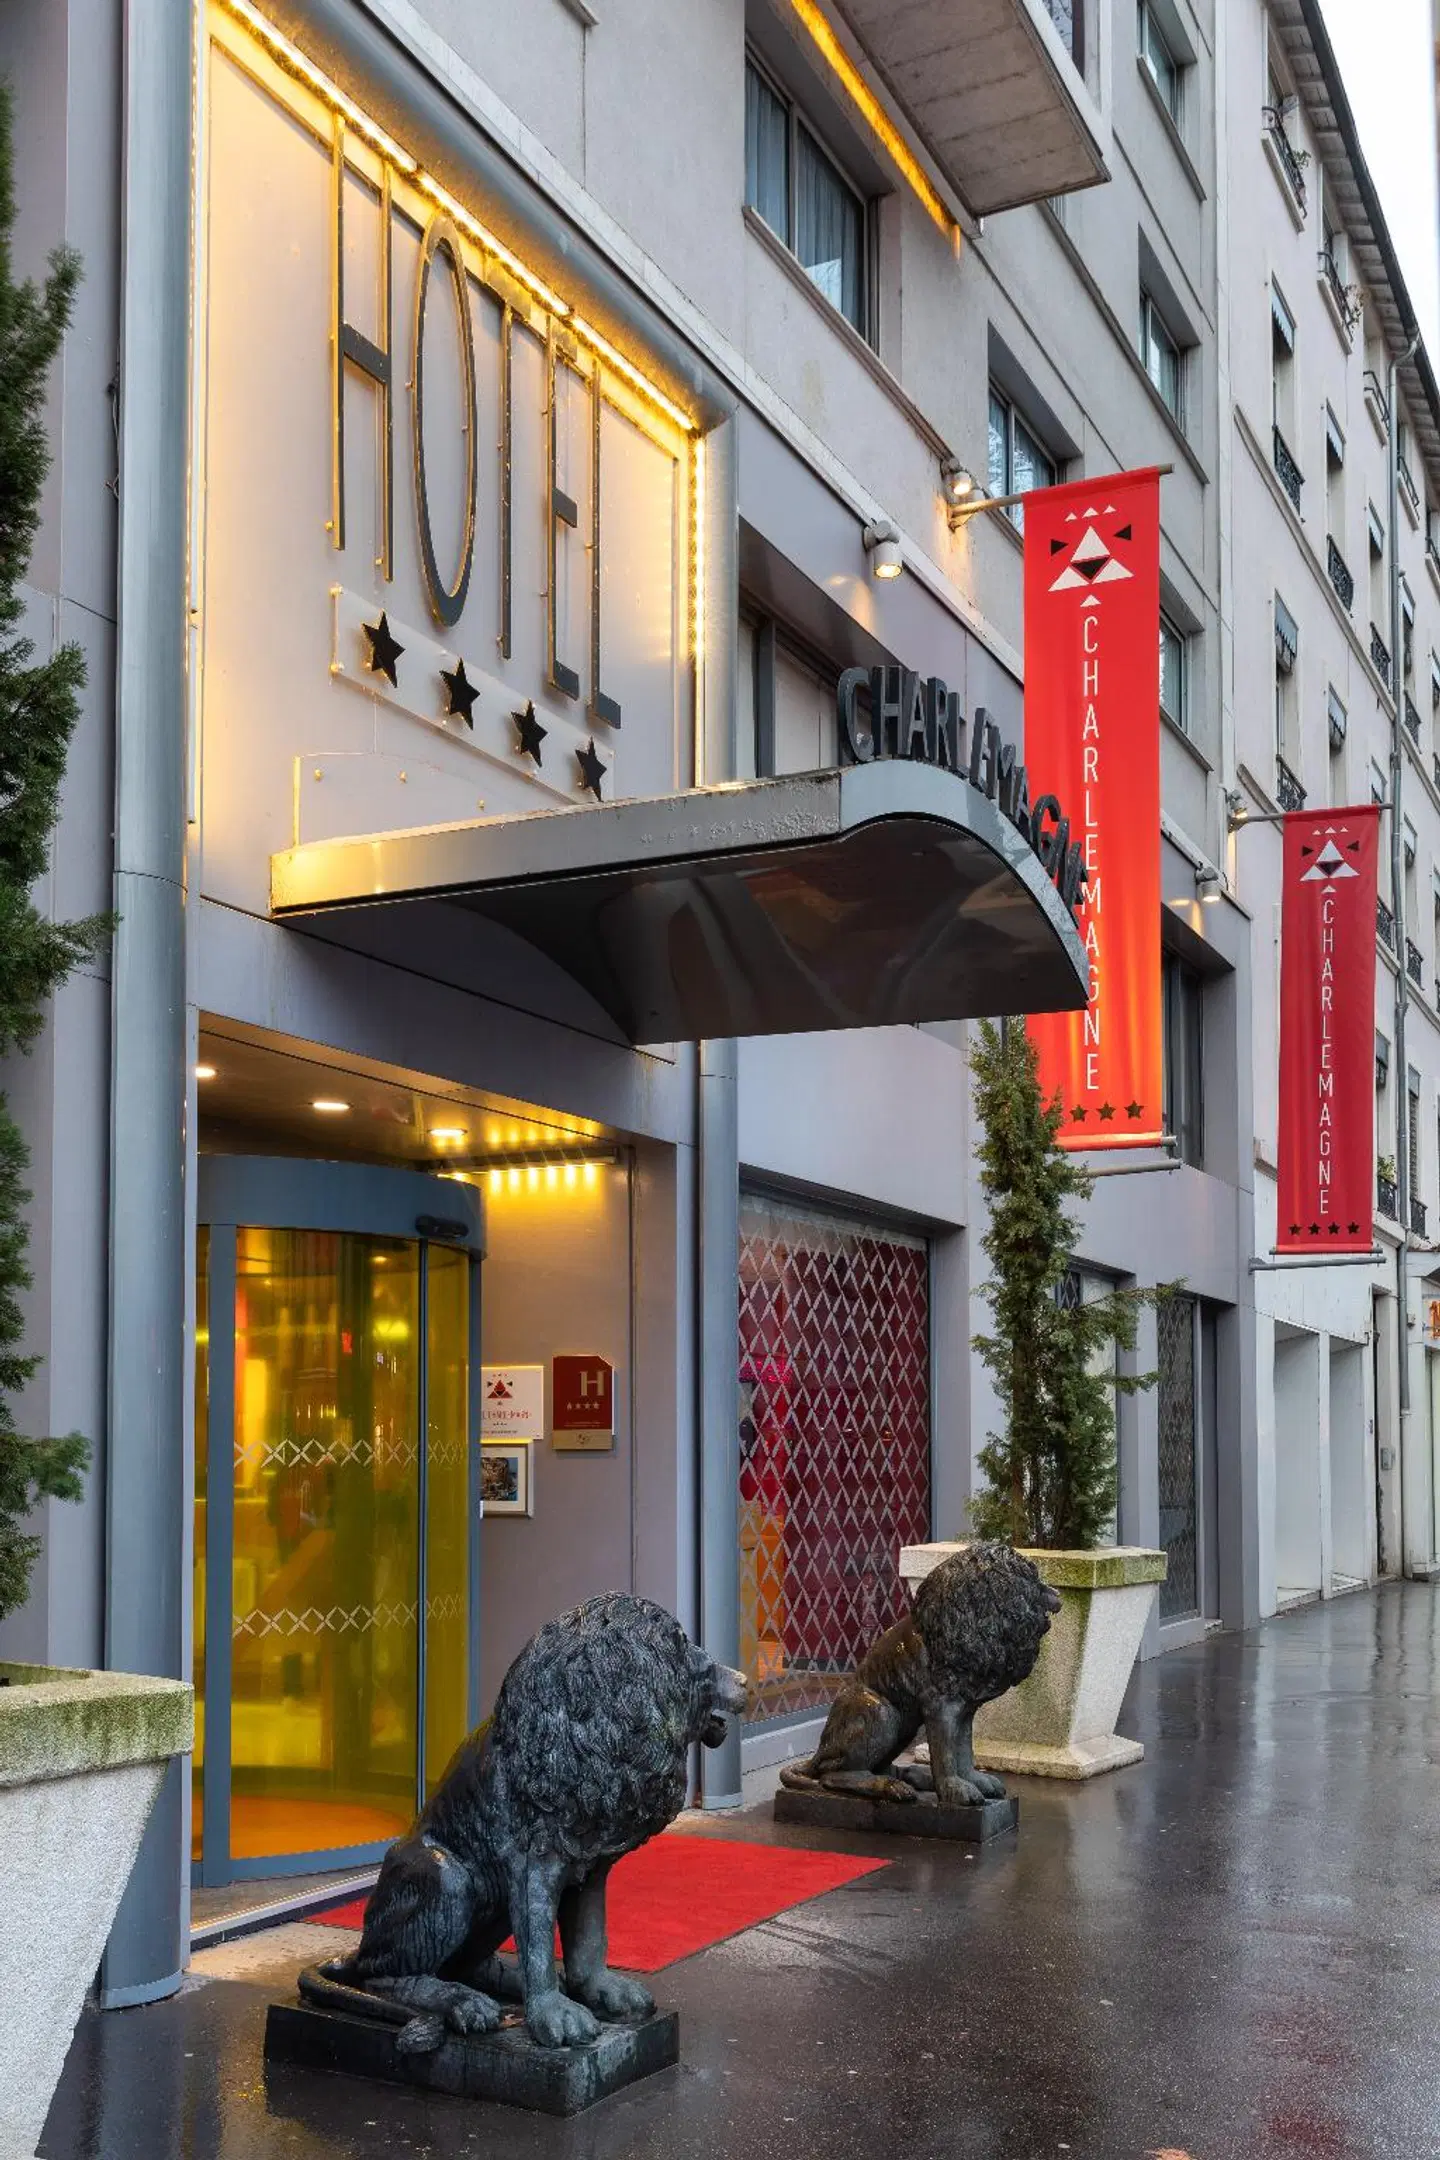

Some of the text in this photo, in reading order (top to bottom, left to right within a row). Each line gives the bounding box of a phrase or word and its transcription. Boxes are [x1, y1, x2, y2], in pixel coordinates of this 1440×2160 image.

[332, 112, 621, 728] HOTEL
[1081, 616, 1101, 1090] CHARLEMAGNE
[1318, 900, 1335, 1215] CHARLEMAGNE
[580, 1371, 605, 1396] H
